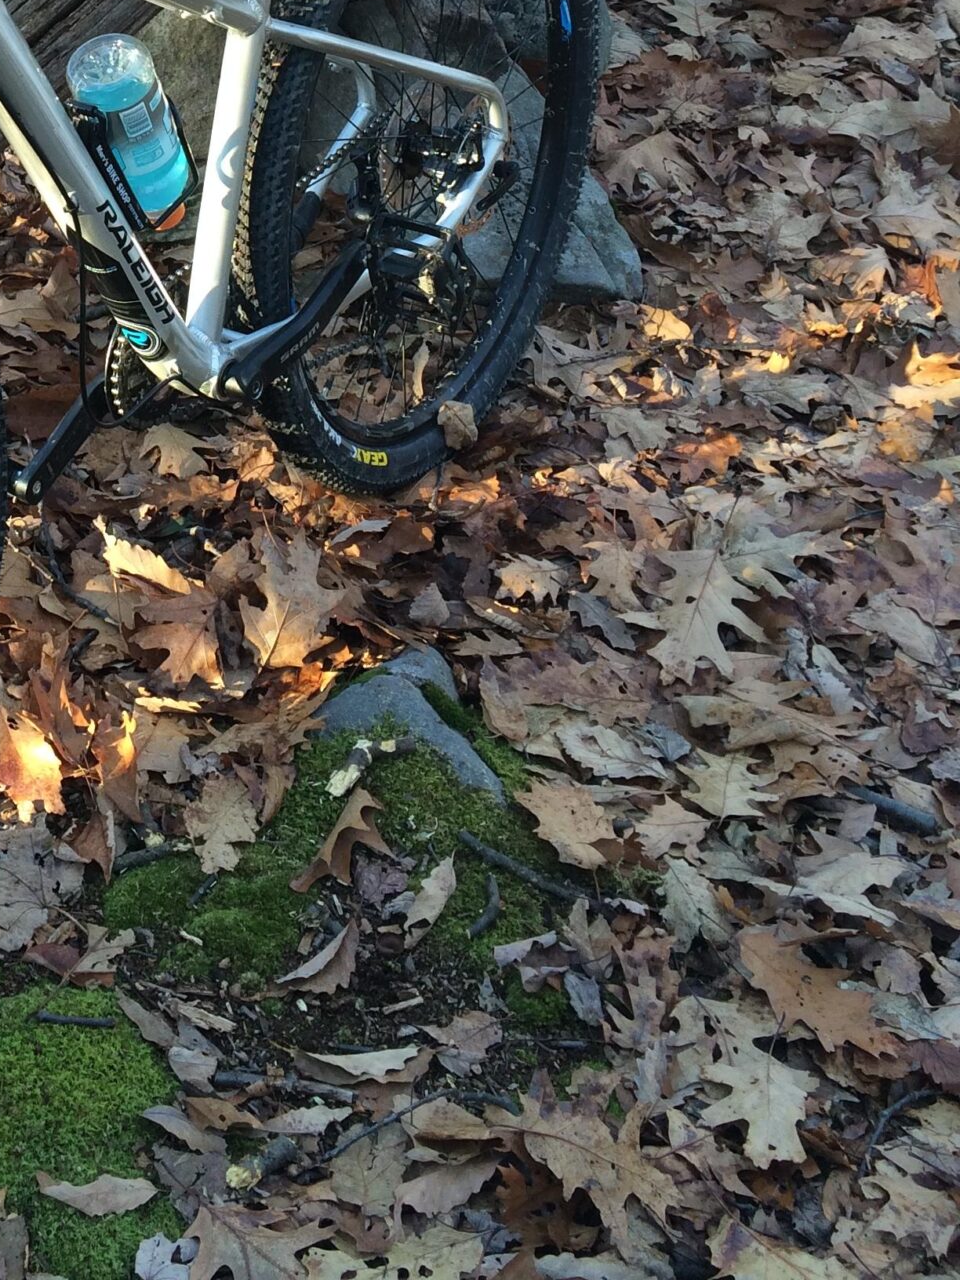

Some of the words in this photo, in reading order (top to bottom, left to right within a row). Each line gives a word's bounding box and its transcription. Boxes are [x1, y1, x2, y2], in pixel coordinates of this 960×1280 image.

[106, 163, 120, 185] BIKE
[116, 183, 131, 204] SHOP
[96, 200, 176, 325] RALEIGH
